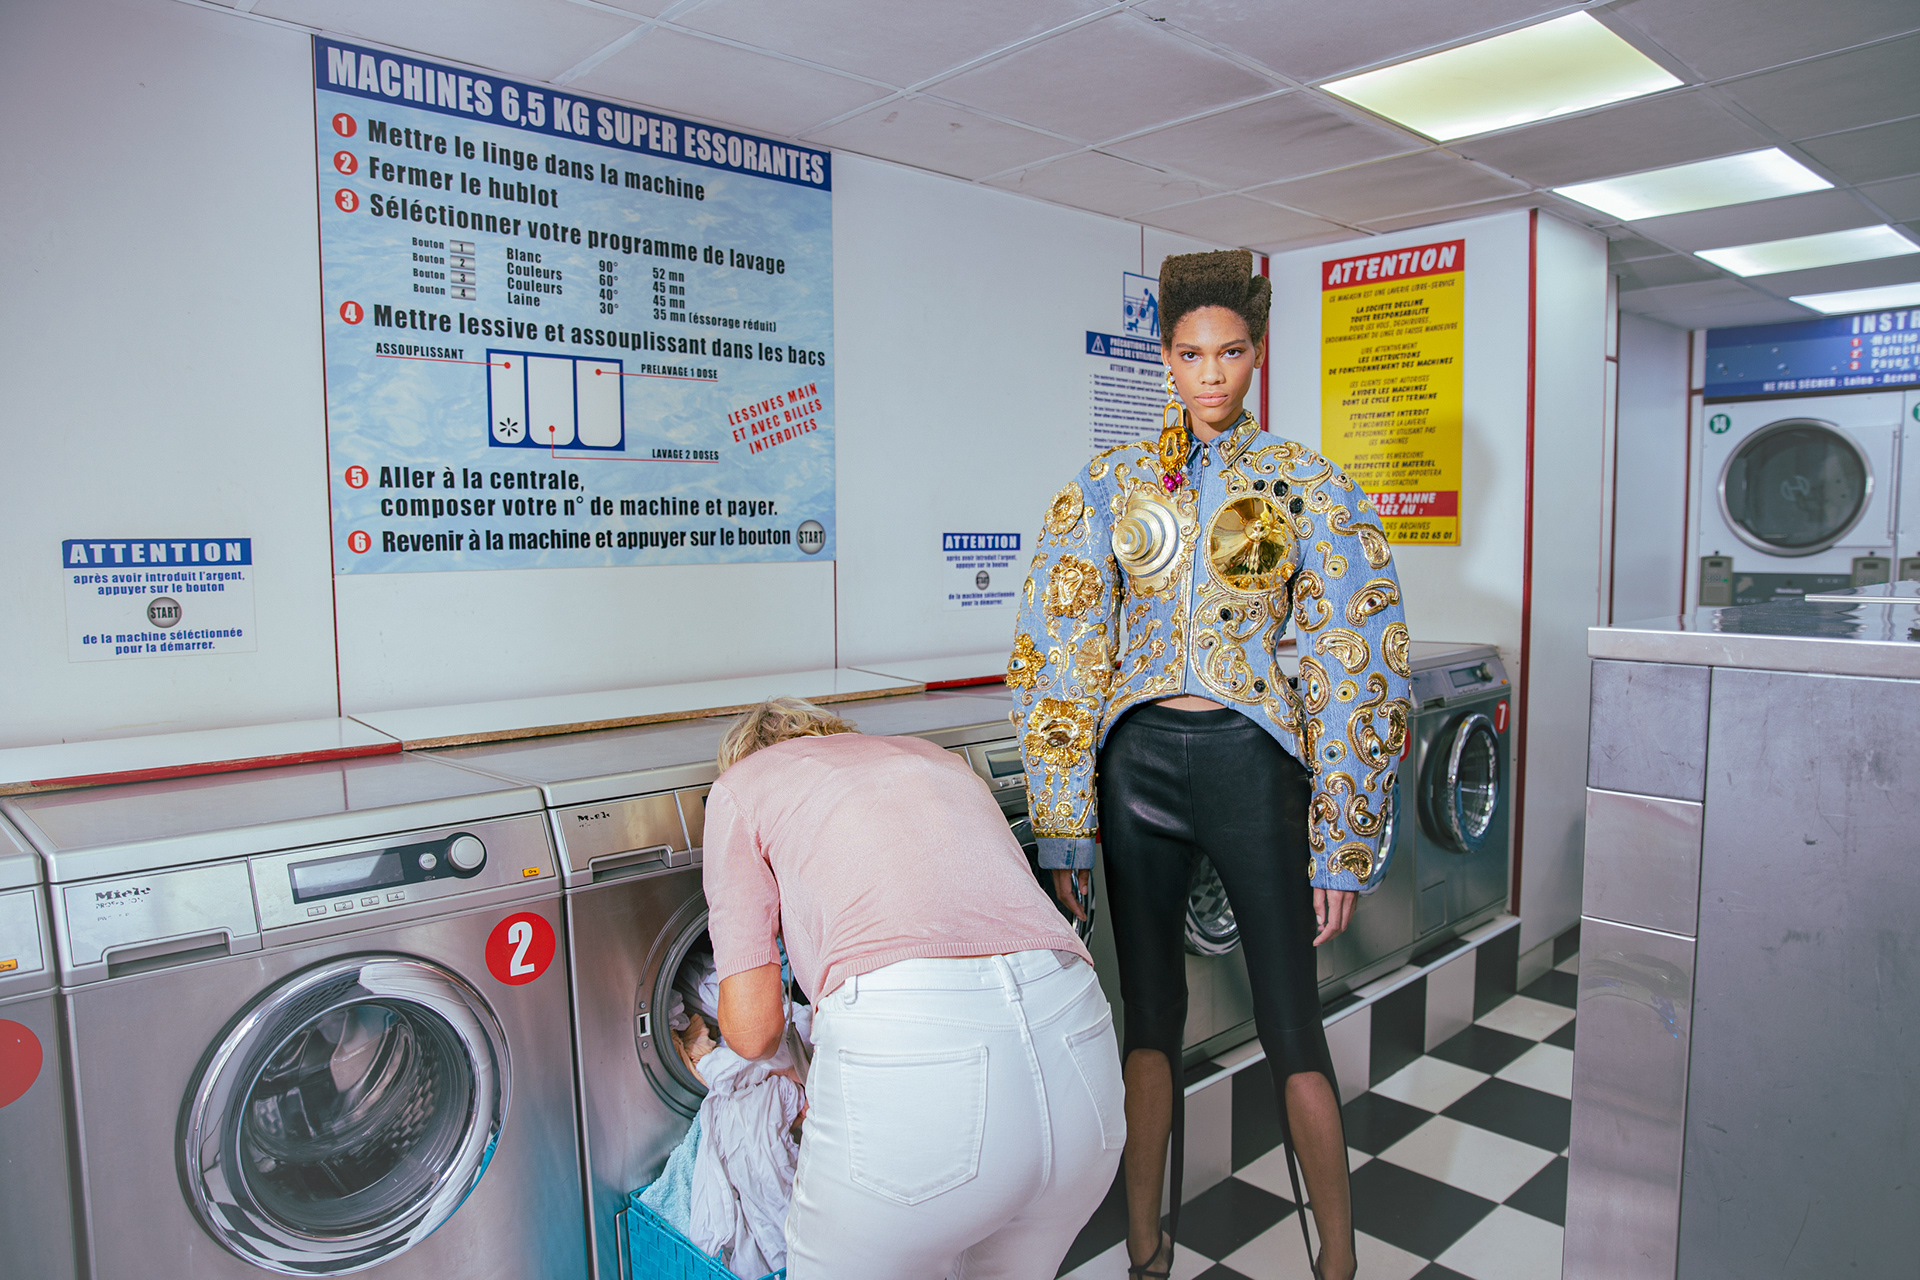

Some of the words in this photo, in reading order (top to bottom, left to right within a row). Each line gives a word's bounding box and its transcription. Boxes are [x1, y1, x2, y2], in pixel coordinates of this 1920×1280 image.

[327, 46, 493, 116] MACHINES
[501, 86, 546, 127] 6,5
[553, 97, 590, 136] KG
[597, 107, 677, 154] SUPER
[684, 126, 824, 184] ESSORANTES
[338, 116, 348, 135] 1
[368, 119, 447, 154] Mettre
[454, 136, 475, 160] le
[483, 141, 538, 171] linge
[545, 154, 595, 181] dans
[601, 164, 618, 186] la
[625, 170, 705, 201] machine
[341, 154, 351, 173] 2
[369, 156, 453, 191] Fermer
[461, 172, 481, 195] le
[489, 177, 558, 208] hublot
[341, 191, 352, 210] 3
[370, 193, 521, 236] Séléctionner
[528, 221, 581, 245] votre
[588, 229, 698, 261] programme
[703, 245, 724, 265] de
[730, 249, 785, 275] lavage
[412, 237, 445, 250] Bouton
[412, 252, 445, 265] Bouton
[506, 248, 542, 264] Blanc
[652, 267, 665, 280] 52
[669, 271, 685, 282] mn
[1328, 245, 1457, 285] ATTENTION
[413, 268, 445, 280] Bouton
[507, 262, 562, 281] Couleurs
[653, 281, 666, 293] 45
[669, 285, 685, 295] mn
[413, 283, 446, 295] Bouton
[507, 277, 563, 295] Couleurs
[653, 295, 666, 307] 45
[669, 298, 685, 309] mn
[508, 292, 541, 307] Laine
[653, 309, 667, 321] 35
[670, 312, 686, 323] mn
[743, 319, 777, 332] réduit)
[345, 304, 357, 322] 4
[374, 304, 451, 333] Mettre
[459, 312, 538, 340] lessive
[545, 323, 565, 343] et
[571, 327, 707, 356] assouplissant
[712, 338, 753, 360] dans
[758, 342, 783, 363] les
[788, 345, 826, 366] bacs
[376, 342, 464, 360] ASSOUPLISSANT
[1417, 357, 1453, 367] MACHINES
[641, 363, 688, 377] PRELAVAGE
[690, 367, 695, 378] 1
[697, 368, 718, 379] DOSE
[728, 395, 785, 426] LESSIVES
[787, 382, 818, 404] MAIN
[733, 430, 747, 443] ET
[751, 415, 781, 437] AVEC
[784, 399, 823, 423] BILLES
[749, 418, 818, 455] INTERDITES
[652, 448, 683, 460] LAVAGE
[685, 449, 691, 460] 2
[693, 450, 719, 461] DOSES
[351, 468, 363, 486] 5
[379, 466, 435, 488] Aller
[443, 467, 455, 489] à
[463, 468, 482, 489] la
[490, 470, 585, 492] centrale,
[380, 496, 495, 519] composer
[503, 497, 557, 516] votre
[564, 496, 584, 516] n°
[591, 497, 613, 515] de
[620, 496, 700, 516] machine
[705, 499, 723, 516] et
[728, 499, 778, 518] payer.
[1381, 493, 1396, 504] DE
[1398, 492, 1436, 504] PANNE
[354, 533, 365, 551] 6
[382, 530, 463, 552] Revenir
[469, 529, 481, 551] à
[486, 530, 504, 550] la
[509, 529, 591, 549] machine
[596, 530, 613, 548] et
[617, 530, 686, 550] appuyer
[690, 530, 716, 546] sur
[720, 528, 735, 546] le
[739, 527, 791, 546] bouton
[799, 531, 823, 545] START
[945, 535, 1017, 549] ATTENTION
[69, 542, 242, 564] ATTENTION
[73, 573, 108, 585] après
[112, 572, 142, 583] avoir
[146, 571, 196, 582] introduit
[199, 571, 246, 582] l'argent,
[98, 585, 147, 596] appuyer
[150, 584, 169, 593] sur
[172, 583, 183, 593] le
[186, 582, 225, 592] bouton
[150, 606, 179, 619] START
[83, 634, 97, 644] de
[101, 633, 112, 643] la
[116, 631, 167, 642] machine
[170, 628, 243, 640] séléctionnée
[116, 644, 142, 655] pour
[146, 642, 157, 652] la
[160, 640, 216, 652] démarrer.
[507, 921, 535, 977] 2
